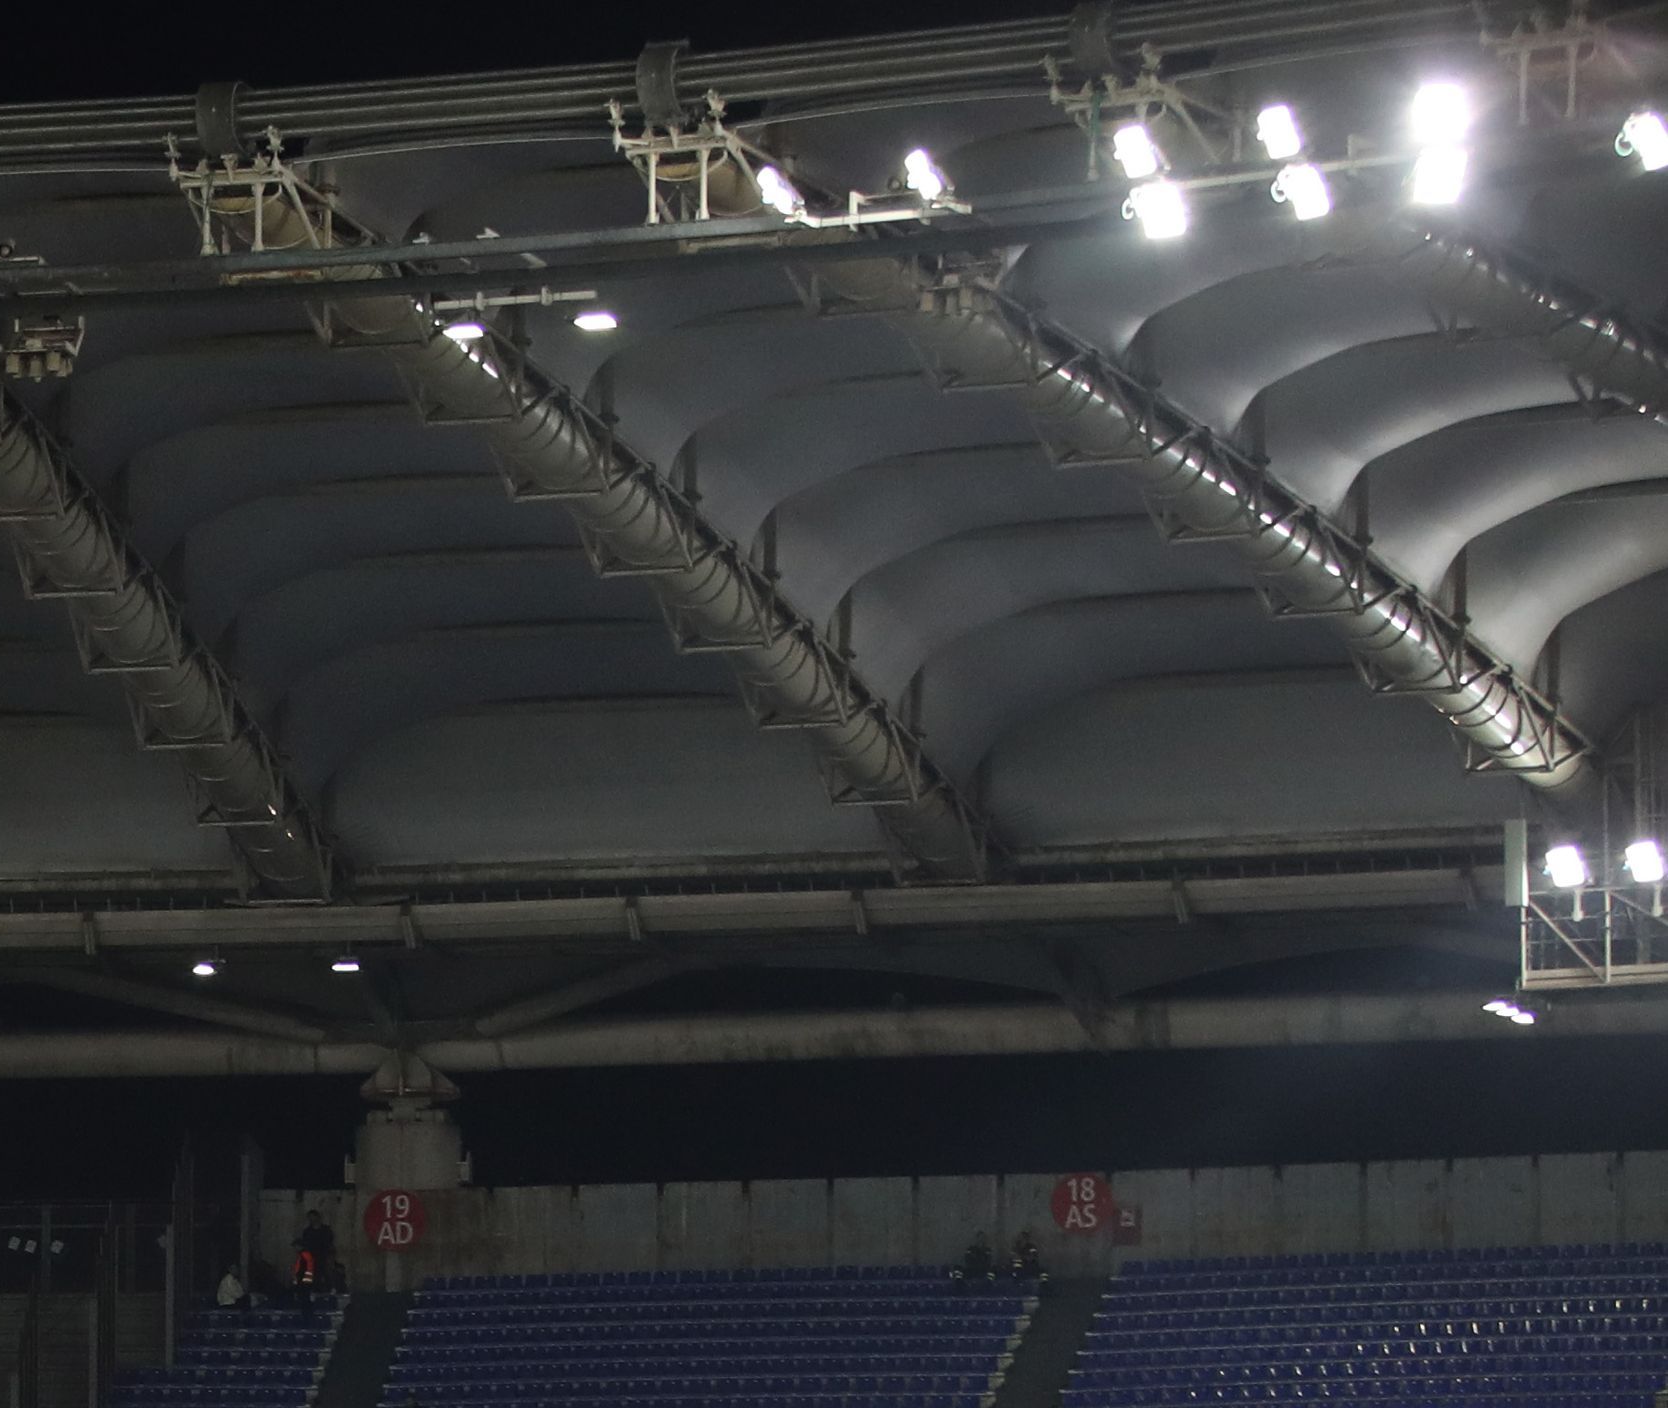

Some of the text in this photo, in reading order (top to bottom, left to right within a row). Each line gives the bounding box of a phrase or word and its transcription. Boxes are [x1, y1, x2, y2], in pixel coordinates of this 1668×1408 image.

[1067, 1178, 1095, 1202] 18
[382, 1195, 410, 1218] 19
[1065, 1204, 1097, 1228] AS
[378, 1222, 413, 1245] AD
